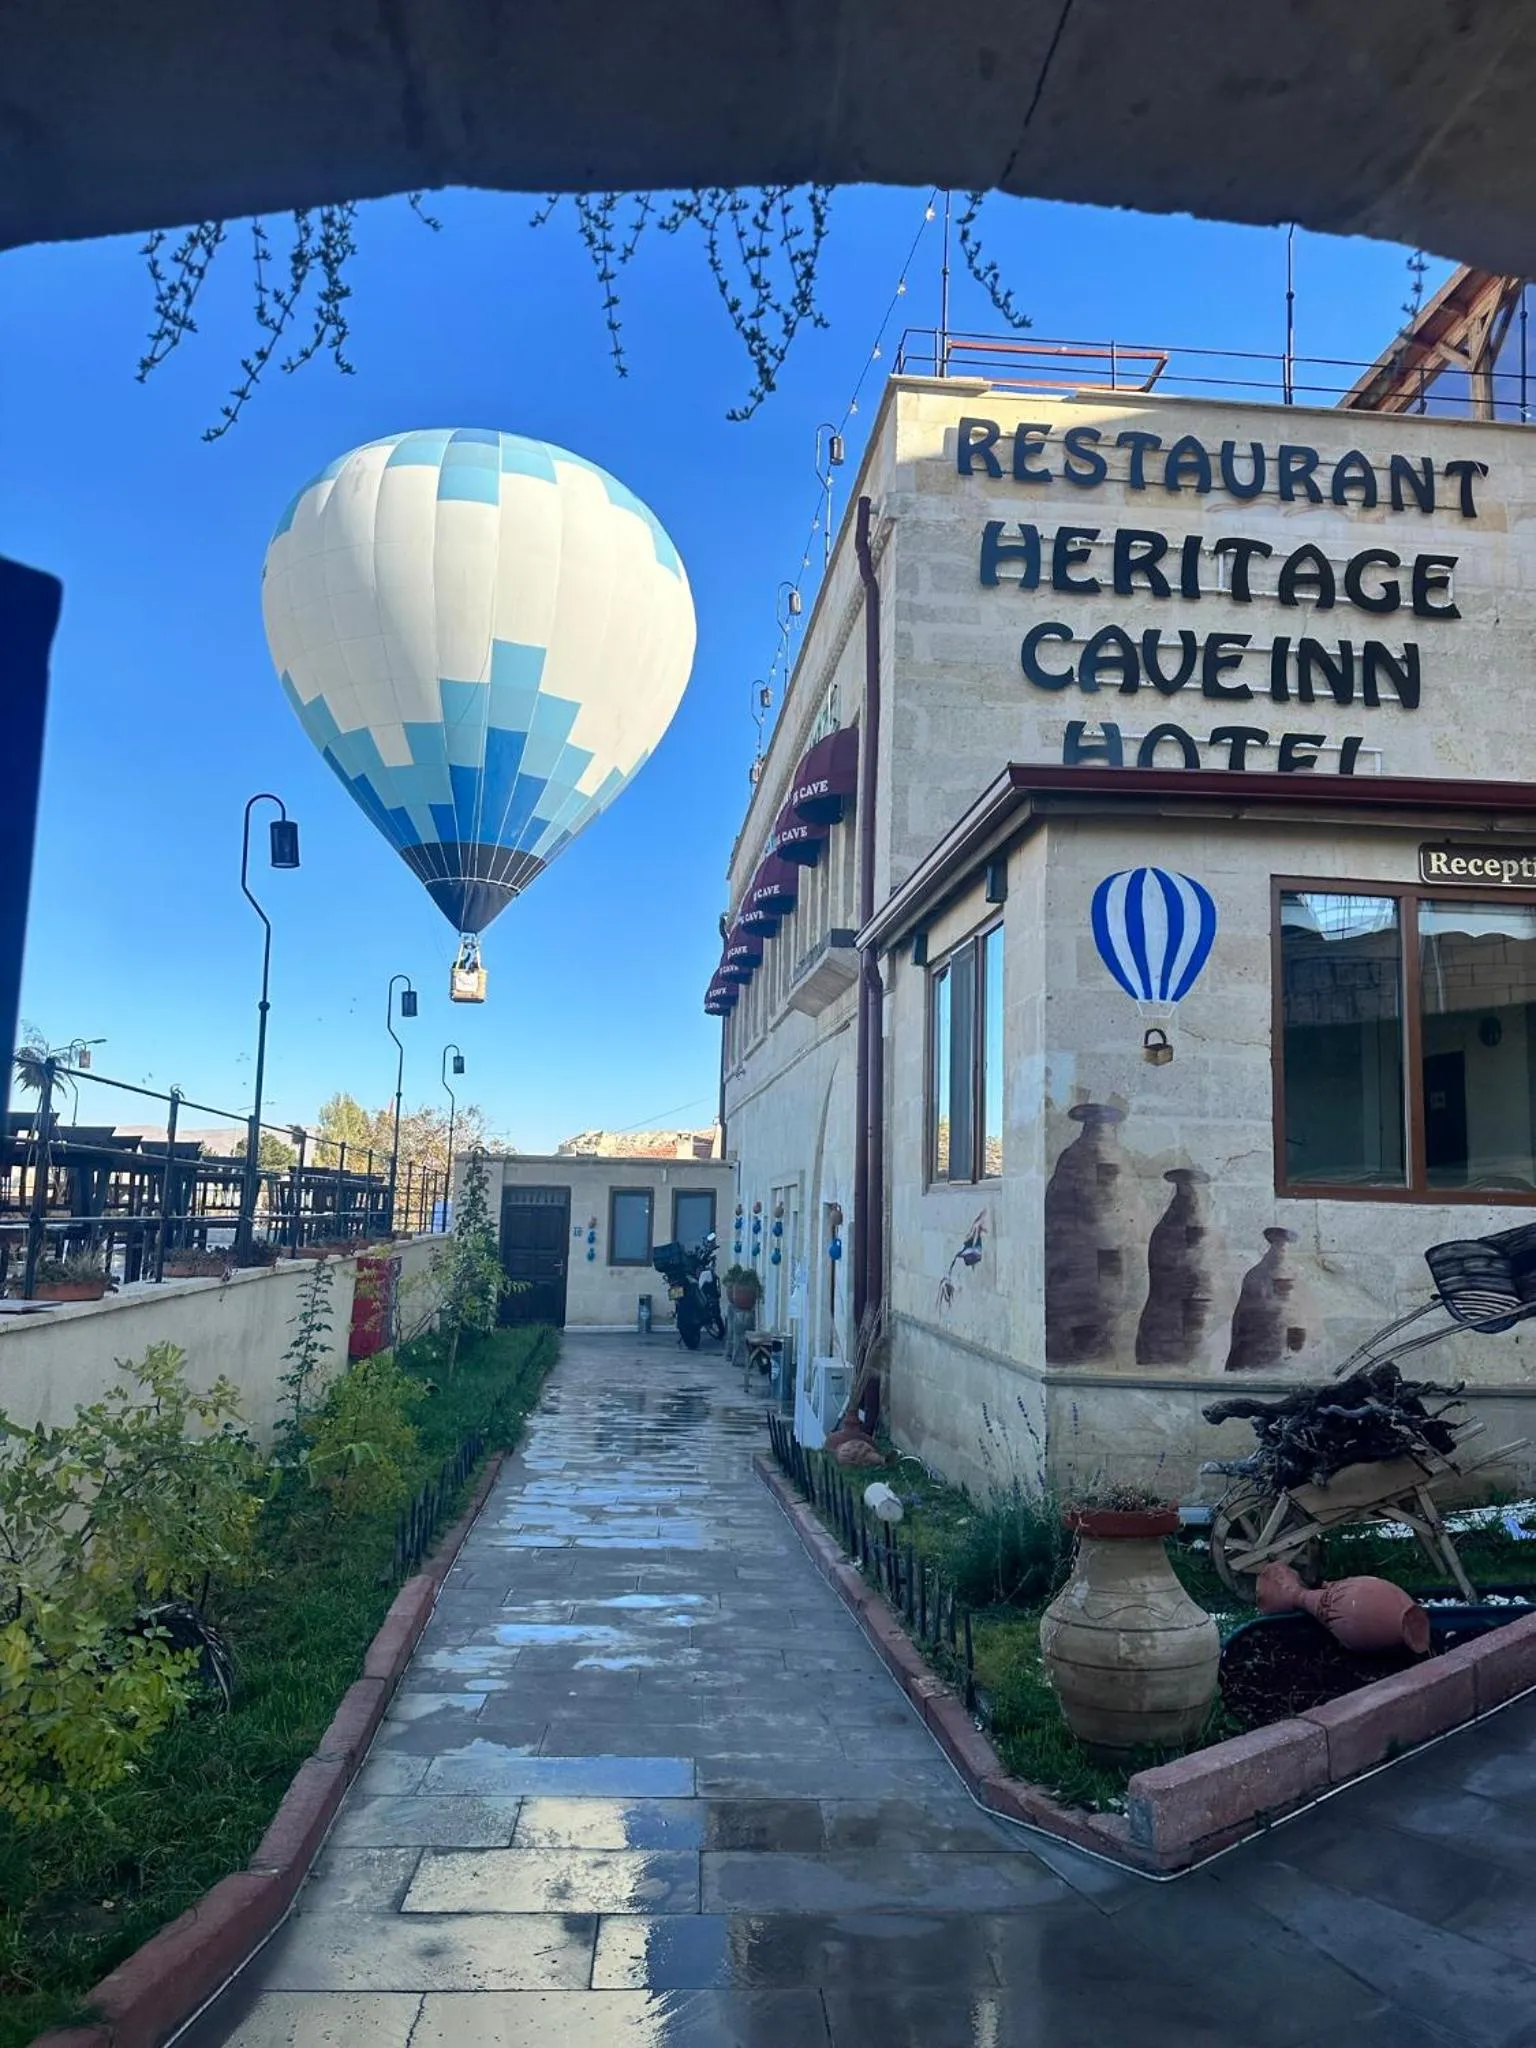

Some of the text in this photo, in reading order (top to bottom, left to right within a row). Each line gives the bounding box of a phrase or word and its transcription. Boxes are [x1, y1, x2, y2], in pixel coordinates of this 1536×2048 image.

[957, 417, 1489, 518] RESTAURANT
[980, 520, 1462, 619] HERITAGE
[800, 779, 829, 799] CAVE
[782, 826, 808, 842] CAVE
